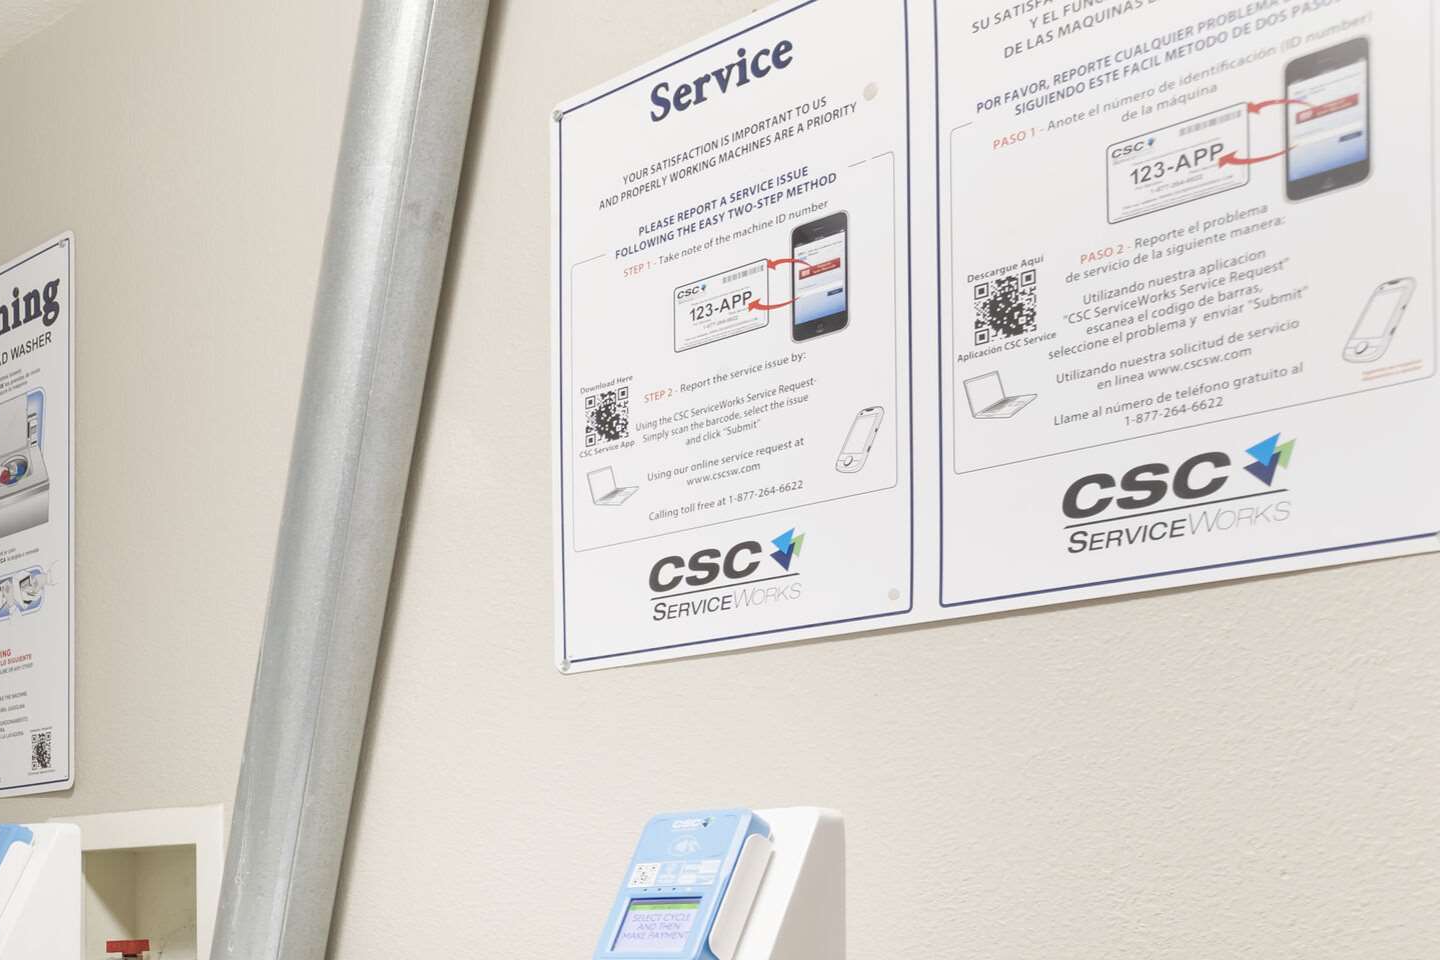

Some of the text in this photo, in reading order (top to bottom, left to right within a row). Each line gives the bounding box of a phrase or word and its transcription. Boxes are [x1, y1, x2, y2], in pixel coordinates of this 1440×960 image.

[650, 39, 794, 123] Service
[599, 103, 856, 209] AND PROPERLY WORKING MACHINES ARE A PRIORITY
[623, 97, 827, 184] YOUR SATISFACTION IS IMPORTANT TO US
[1130, 142, 1224, 186] 123-APP
[615, 173, 837, 259] FOLLOWING THE EASY TWO-STEP METHOD
[638, 166, 808, 235] PLEASE REPORT A SERVICE ISSUE
[677, 285, 699, 300] CSC
[1082, 250, 1266, 305] Utilizando nuestra aplicacion
[689, 290, 752, 322] 123-APP
[10, 331, 52, 361] WASHER
[1125, 396, 1223, 425] 1-877-264-6622
[648, 479, 803, 521] Calling toll free at 1-877-264-6622
[1061, 451, 1232, 519] CSC
[649, 540, 762, 593] CSC
